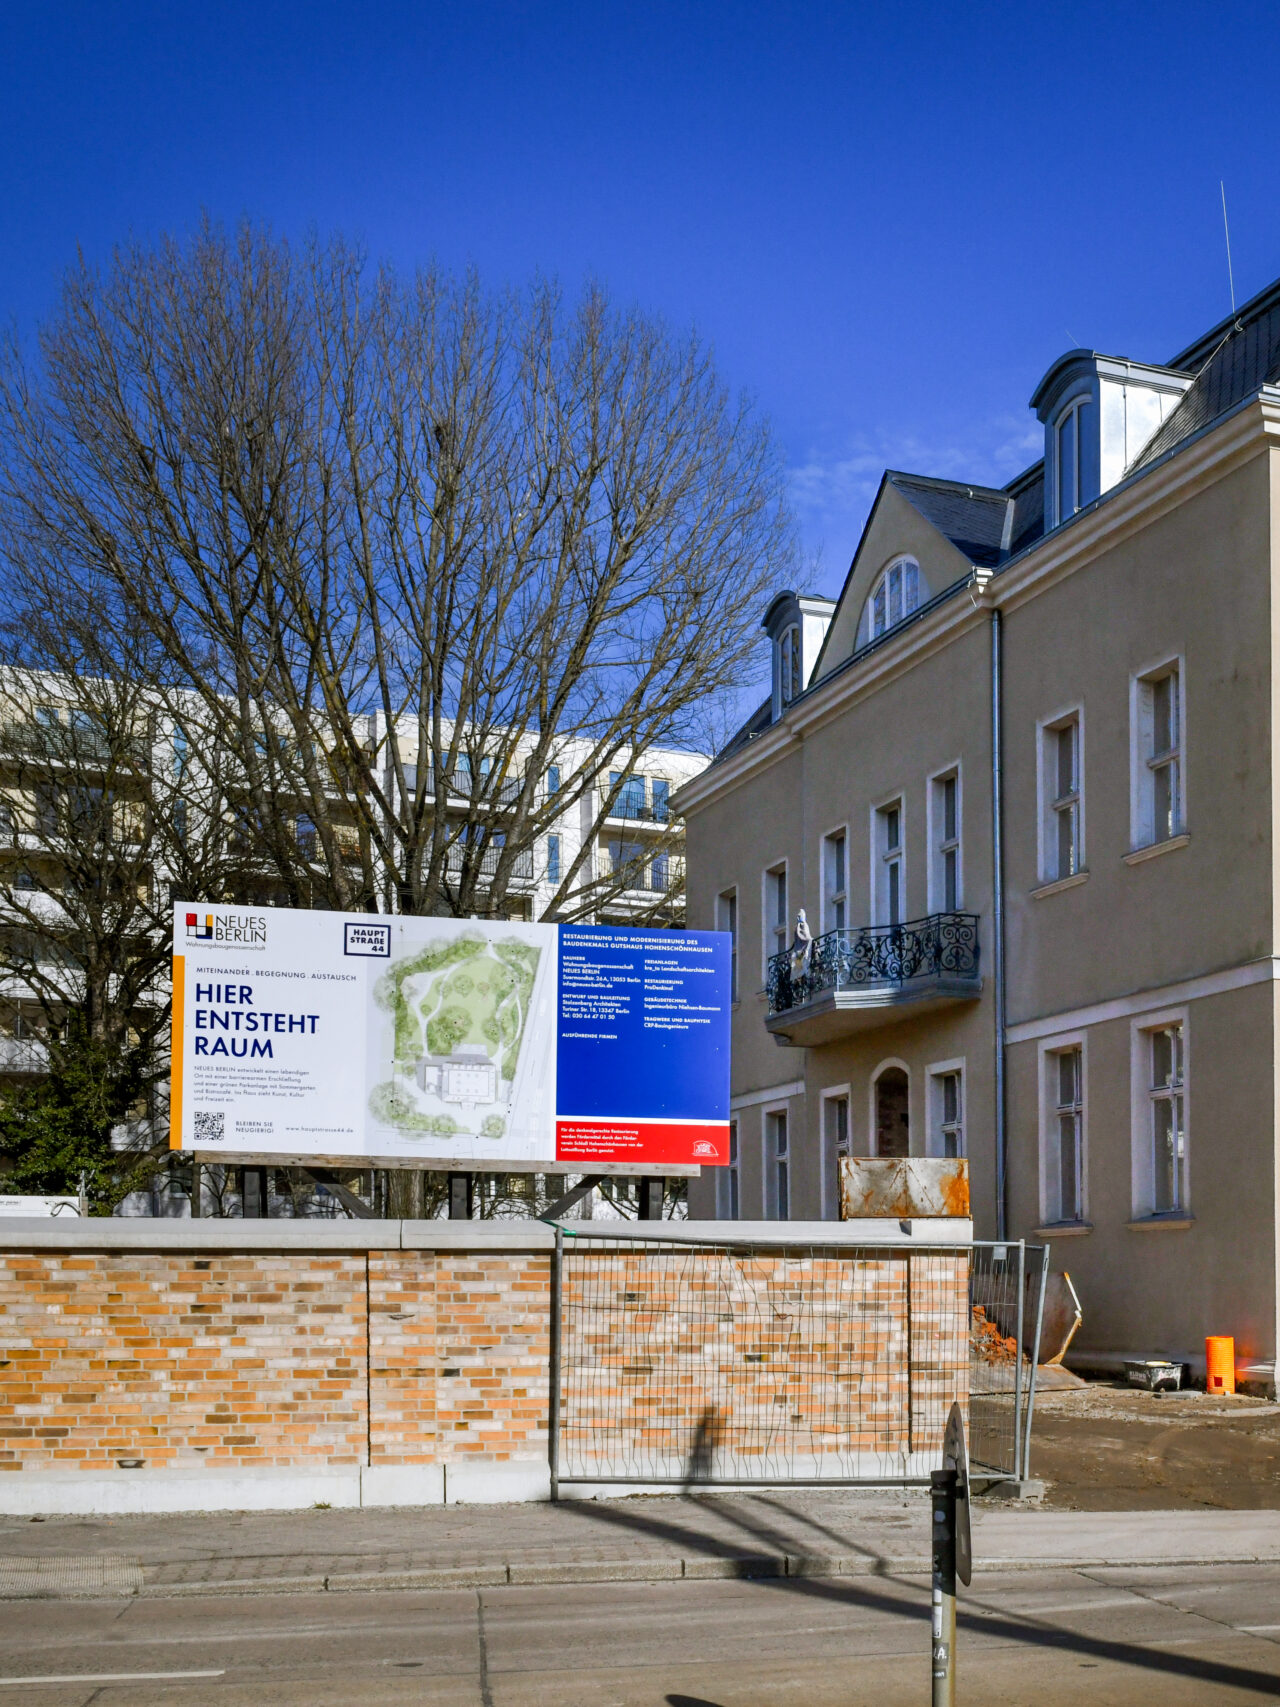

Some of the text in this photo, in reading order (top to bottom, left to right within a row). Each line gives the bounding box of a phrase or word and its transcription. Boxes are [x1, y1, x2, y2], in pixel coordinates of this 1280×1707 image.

[216, 915, 267, 930] NEUES
[216, 928, 266, 942] BERLIN
[353, 929, 385, 937] HAUPT
[563, 933, 612, 942] RESTAURIERUNG
[630, 936, 685, 945] MODERNISIERUNG
[371, 945, 384, 953] 44
[563, 940, 609, 948] BAUDENKMALS
[645, 944, 713, 953] HOHENSCHÖNHAUSEN
[196, 967, 356, 981] MITEINANDER BEGEGNUNG AUSTAUSCH
[196, 983, 253, 1005] HIER
[196, 1009, 320, 1034] ENTSTEHT
[195, 1036, 273, 1058] RAUM
